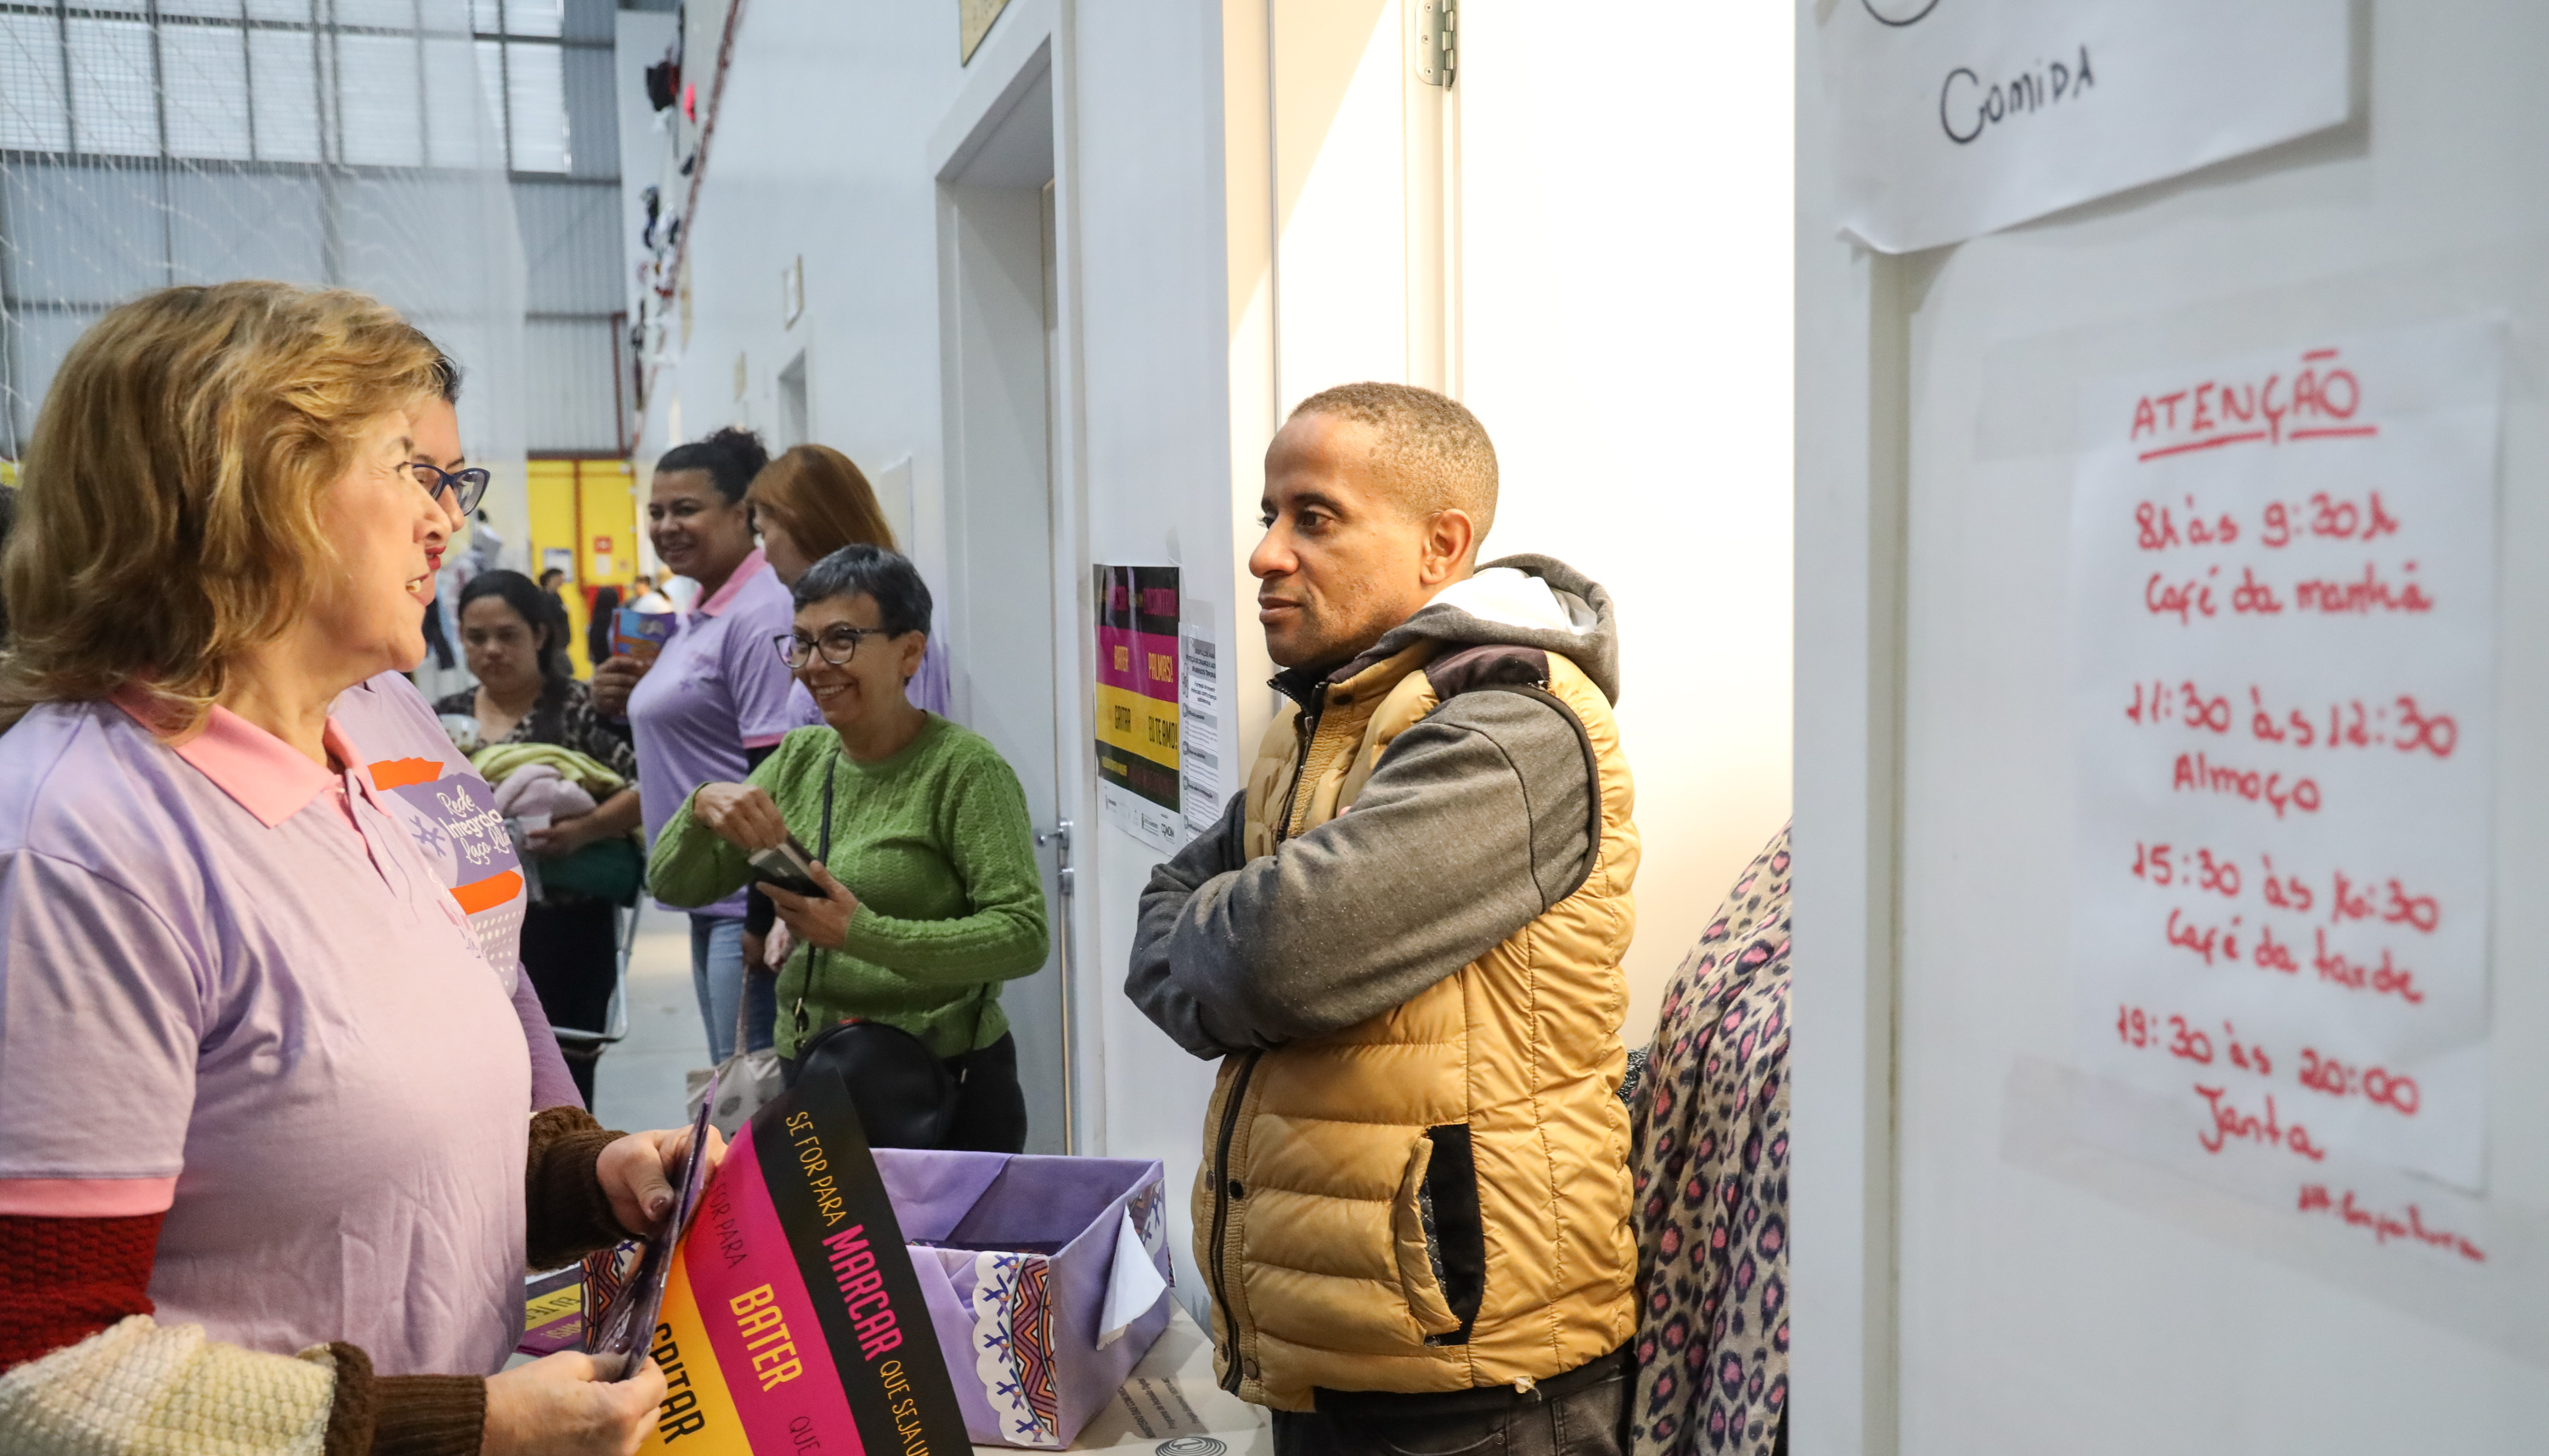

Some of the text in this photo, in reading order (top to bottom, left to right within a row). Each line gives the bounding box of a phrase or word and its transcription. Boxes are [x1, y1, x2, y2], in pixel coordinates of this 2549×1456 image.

[2132, 349, 2359, 444] ATENÇÃO
[2145, 565, 2218, 625] Café
[2232, 567, 2283, 614] da
[1148, 652, 1173, 683] PALMAS!
[1149, 716, 1155, 742] EU
[1156, 718, 1161, 745] TE
[2127, 681, 2457, 758] 11:30 às 12:30
[437, 785, 475, 817] Rede
[2173, 752, 2320, 818] Almoço
[460, 826, 511, 865] Laço Lilá
[2133, 843, 2241, 897] 15:30
[2262, 855, 2313, 911] às
[2167, 909, 2423, 1004] Café da tarde
[2117, 1005, 2420, 1116] 19:30 às 20:00
[2195, 1082, 2325, 1161] Janta
[715, 1218, 748, 1269] PARA
[785, 1111, 930, 1456] SE FOR PARA MARCAR QUE SEJA U
[728, 1284, 803, 1392] BATER
